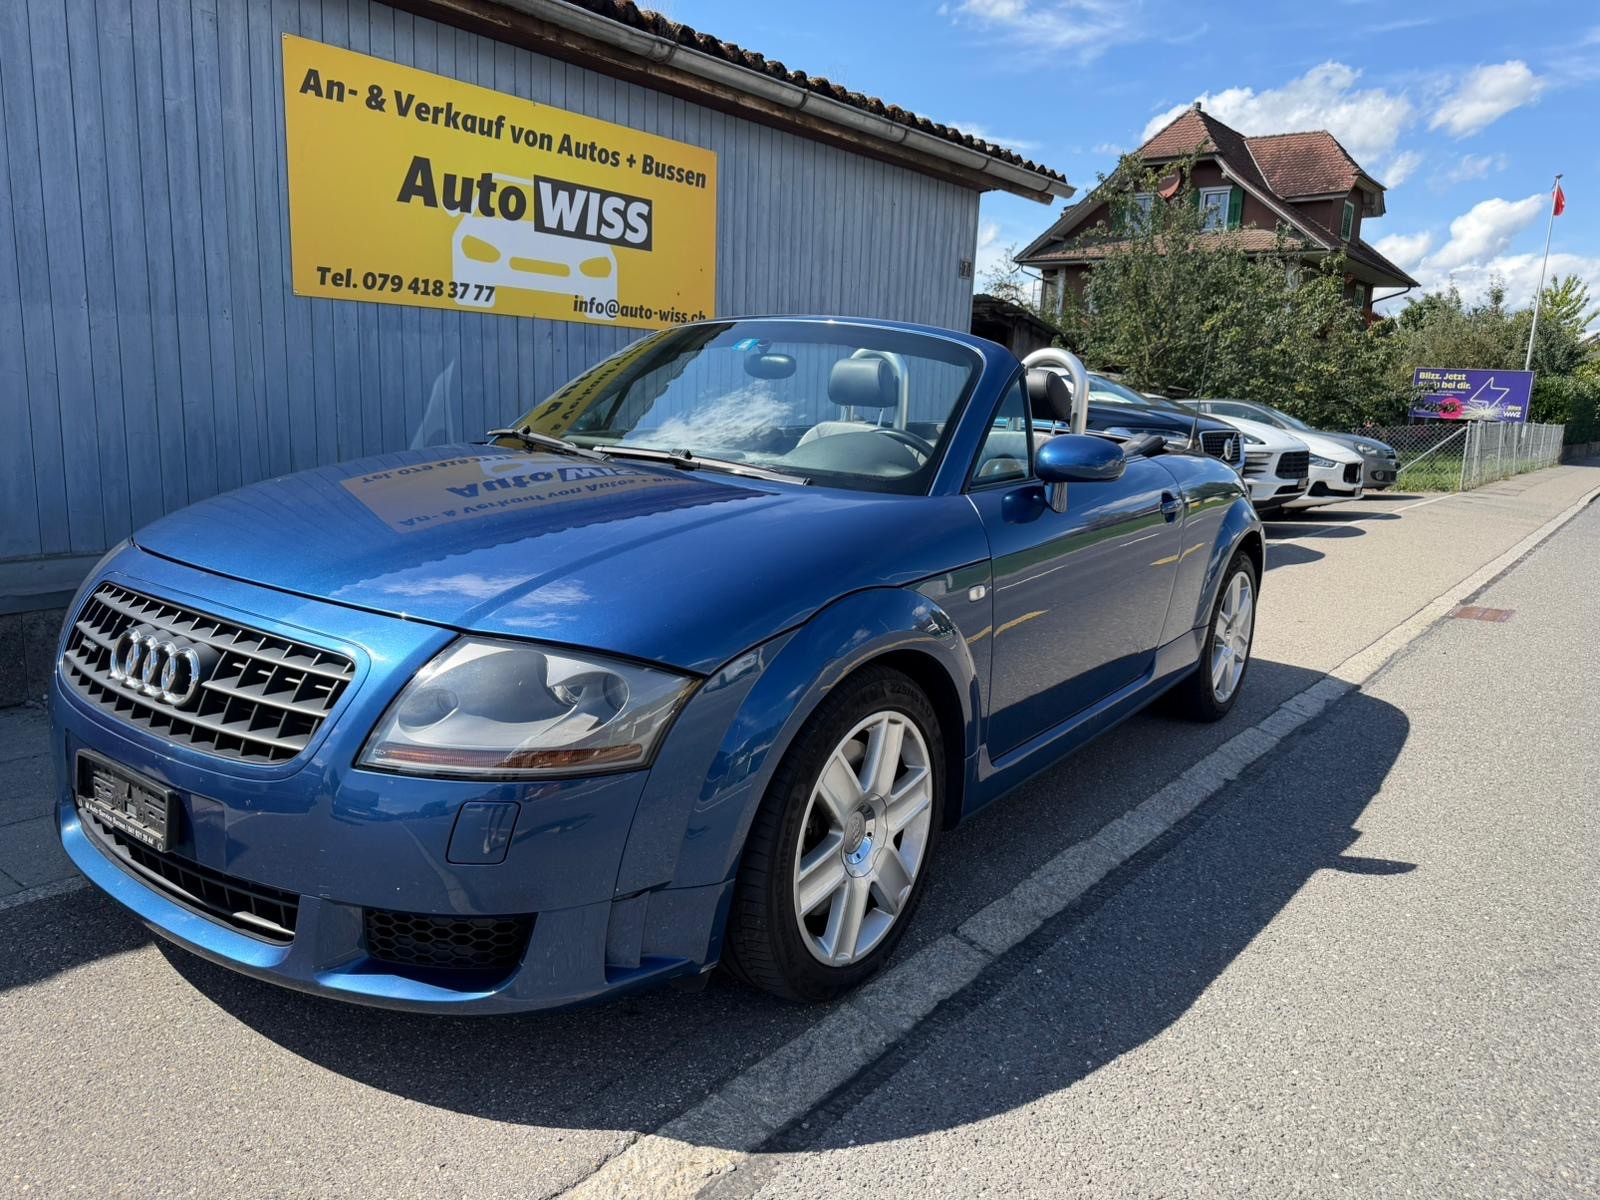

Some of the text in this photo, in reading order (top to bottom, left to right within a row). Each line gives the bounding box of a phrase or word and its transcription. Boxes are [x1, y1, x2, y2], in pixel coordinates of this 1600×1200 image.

[299, 68, 707, 189] An- & Verkauf von Autos + Bussen
[397, 155, 650, 244] Auto WISS
[316, 265, 496, 302] Tel. 079 418 37 77
[1441, 381, 1456, 389] bei
[1457, 381, 1471, 389] dir.
[1443, 372, 1466, 381] Jetzt
